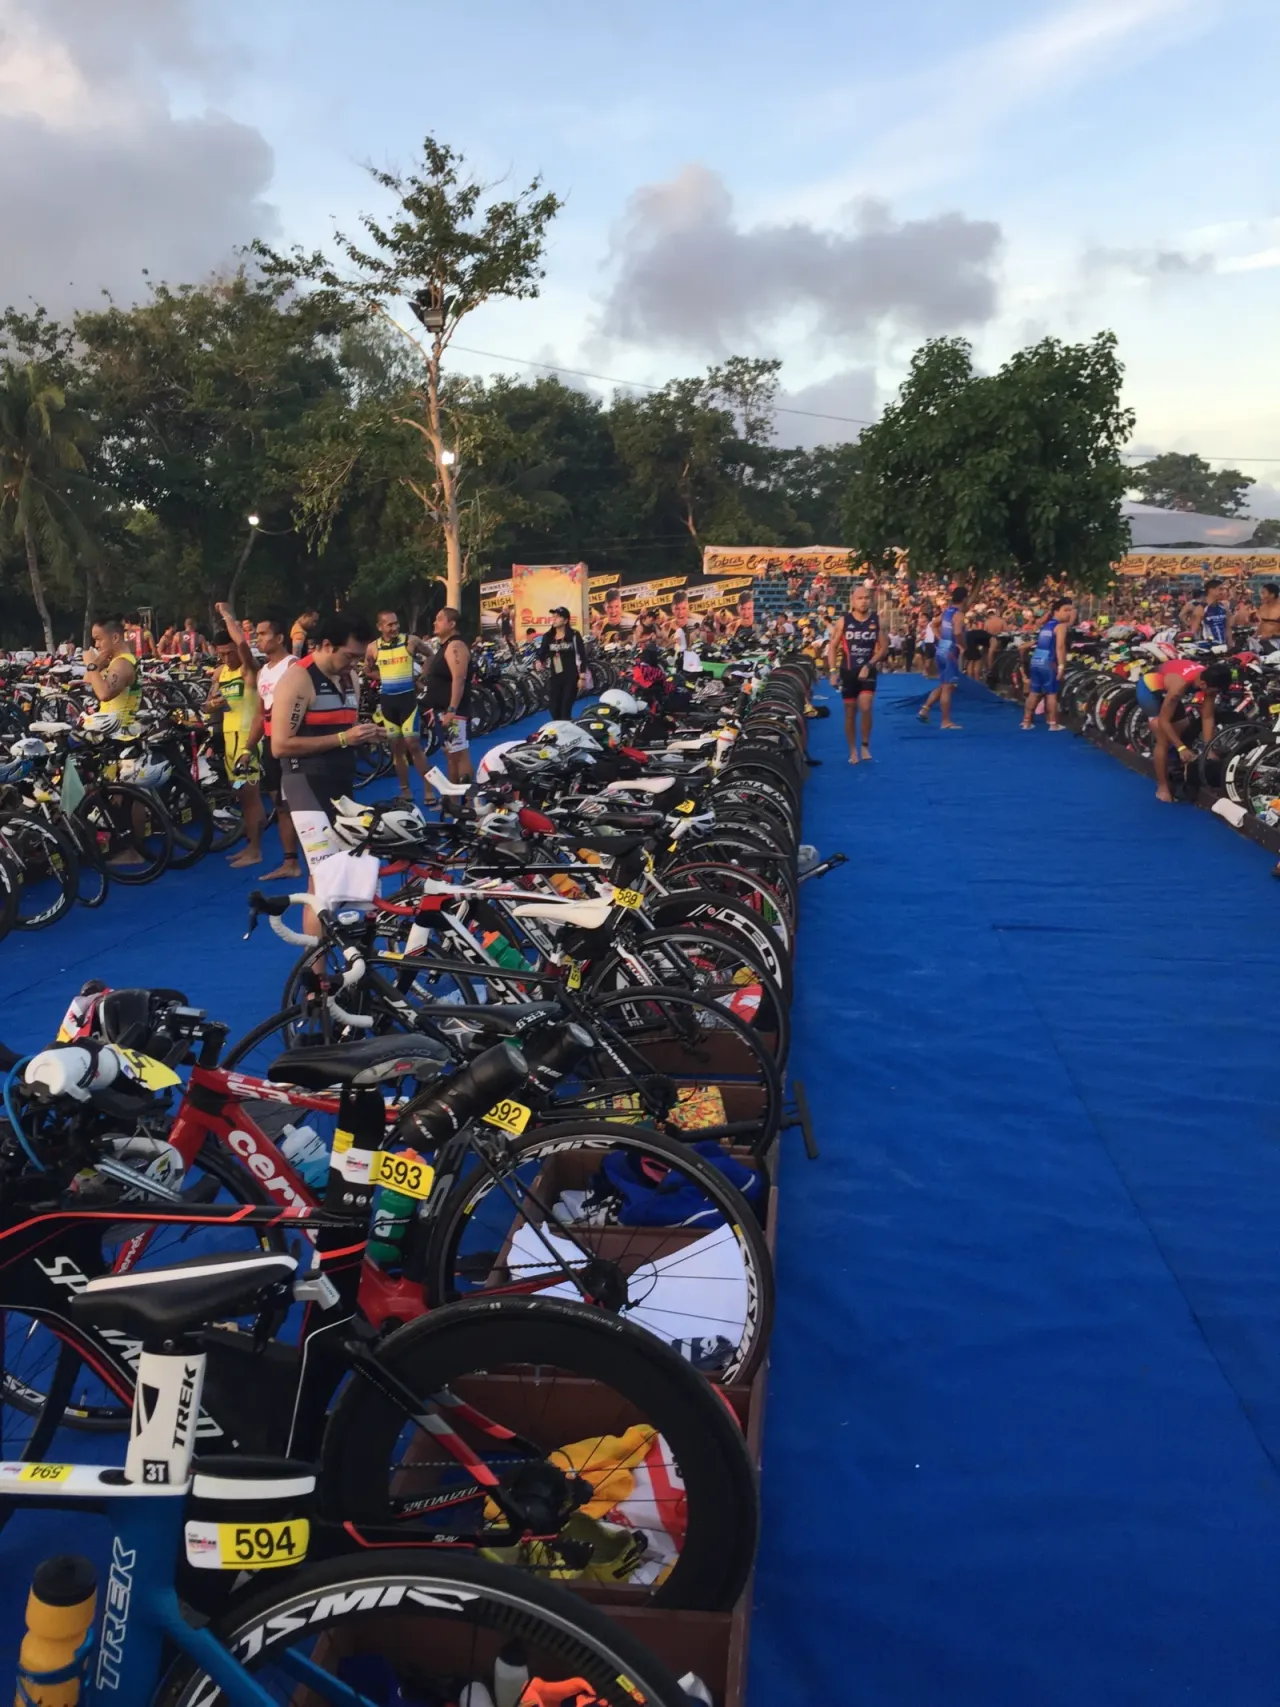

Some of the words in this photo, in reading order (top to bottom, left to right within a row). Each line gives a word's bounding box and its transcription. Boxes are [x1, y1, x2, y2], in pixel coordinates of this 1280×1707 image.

[708, 553, 745, 567] Cobra
[482, 597, 512, 609] FINISH
[623, 600, 652, 613] FINISH
[655, 595, 674, 606] LINE
[690, 600, 717, 613] FINISH
[719, 595, 738, 607] LINE
[845, 630, 877, 641] DECA
[618, 890, 639, 906] 589
[599, 1037, 632, 1075] JAMIS
[227, 1081, 292, 1105] S3
[379, 1155, 423, 1191] 593
[172, 1363, 197, 1450] TREK
[29, 1465, 64, 1480] 594
[145, 1461, 168, 1484] 3T
[403, 1486, 478, 1513] SPECIALIZED
[234, 1526, 296, 1560] 594
[433, 1533, 459, 1543] SHIV
[96, 1536, 136, 1690] TREK
